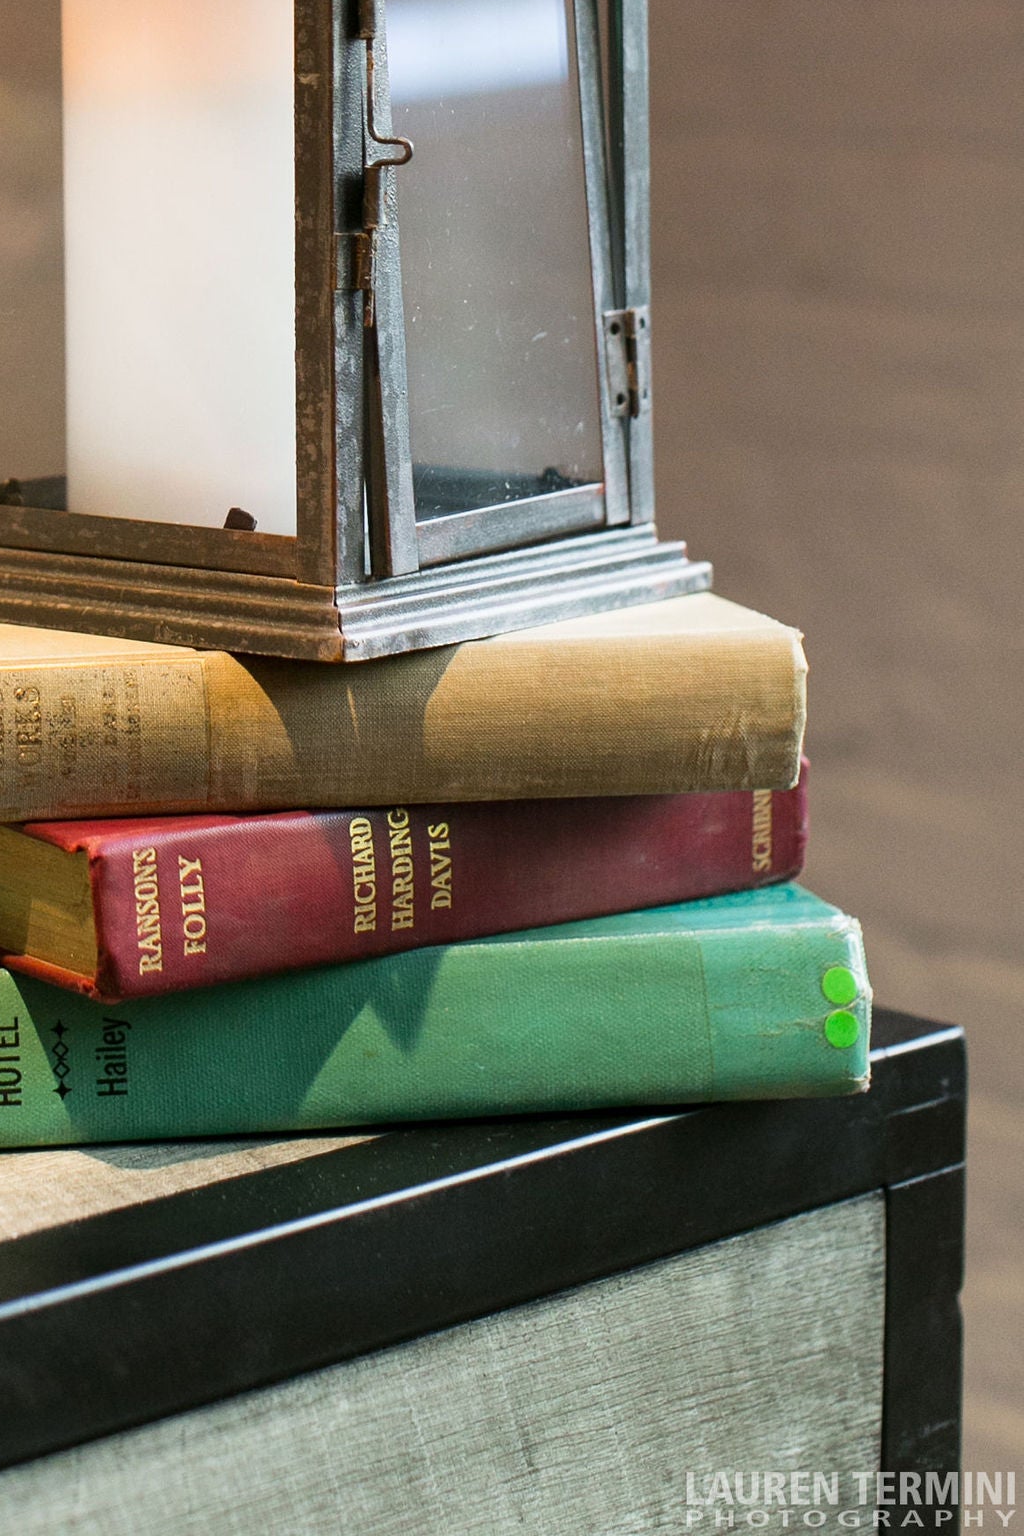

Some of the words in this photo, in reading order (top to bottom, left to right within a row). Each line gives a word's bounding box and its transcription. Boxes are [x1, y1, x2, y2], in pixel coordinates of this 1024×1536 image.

[178, 855, 207, 956] FOLLY
[349, 817, 376, 934] RICHARD
[387, 808, 414, 931] HARDING
[428, 822, 452, 910] DAVIS
[95, 1017, 132, 1097] Hailey
